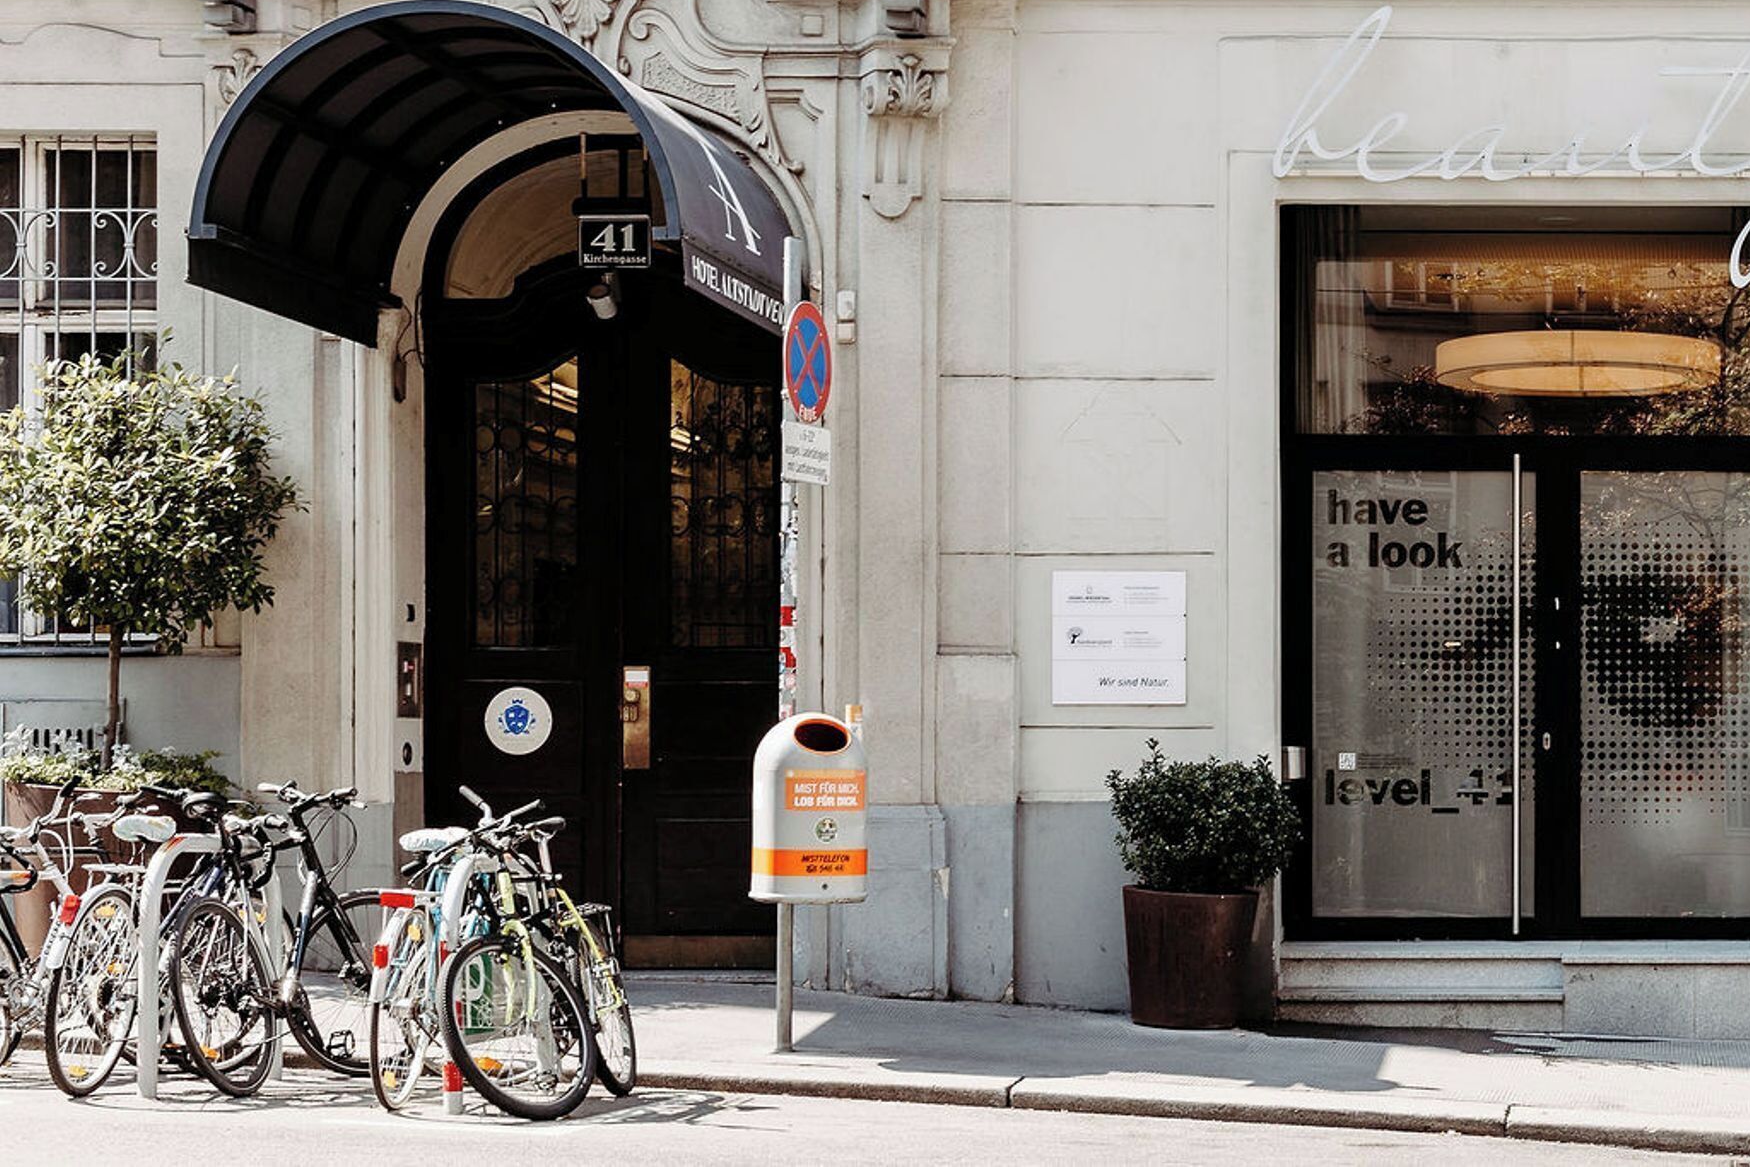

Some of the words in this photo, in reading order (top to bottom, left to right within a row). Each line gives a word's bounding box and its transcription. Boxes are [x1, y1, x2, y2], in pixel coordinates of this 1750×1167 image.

[590, 223, 636, 252] 41
[583, 253, 647, 265] Kirchengasse
[691, 255, 720, 293] HOTEL
[1328, 489, 1428, 526] have
[1328, 542, 1350, 568] a
[1369, 533, 1462, 568] look
[1098, 677, 1115, 687] Wir
[1117, 677, 1139, 687] sind
[794, 783, 817, 794] MIST
